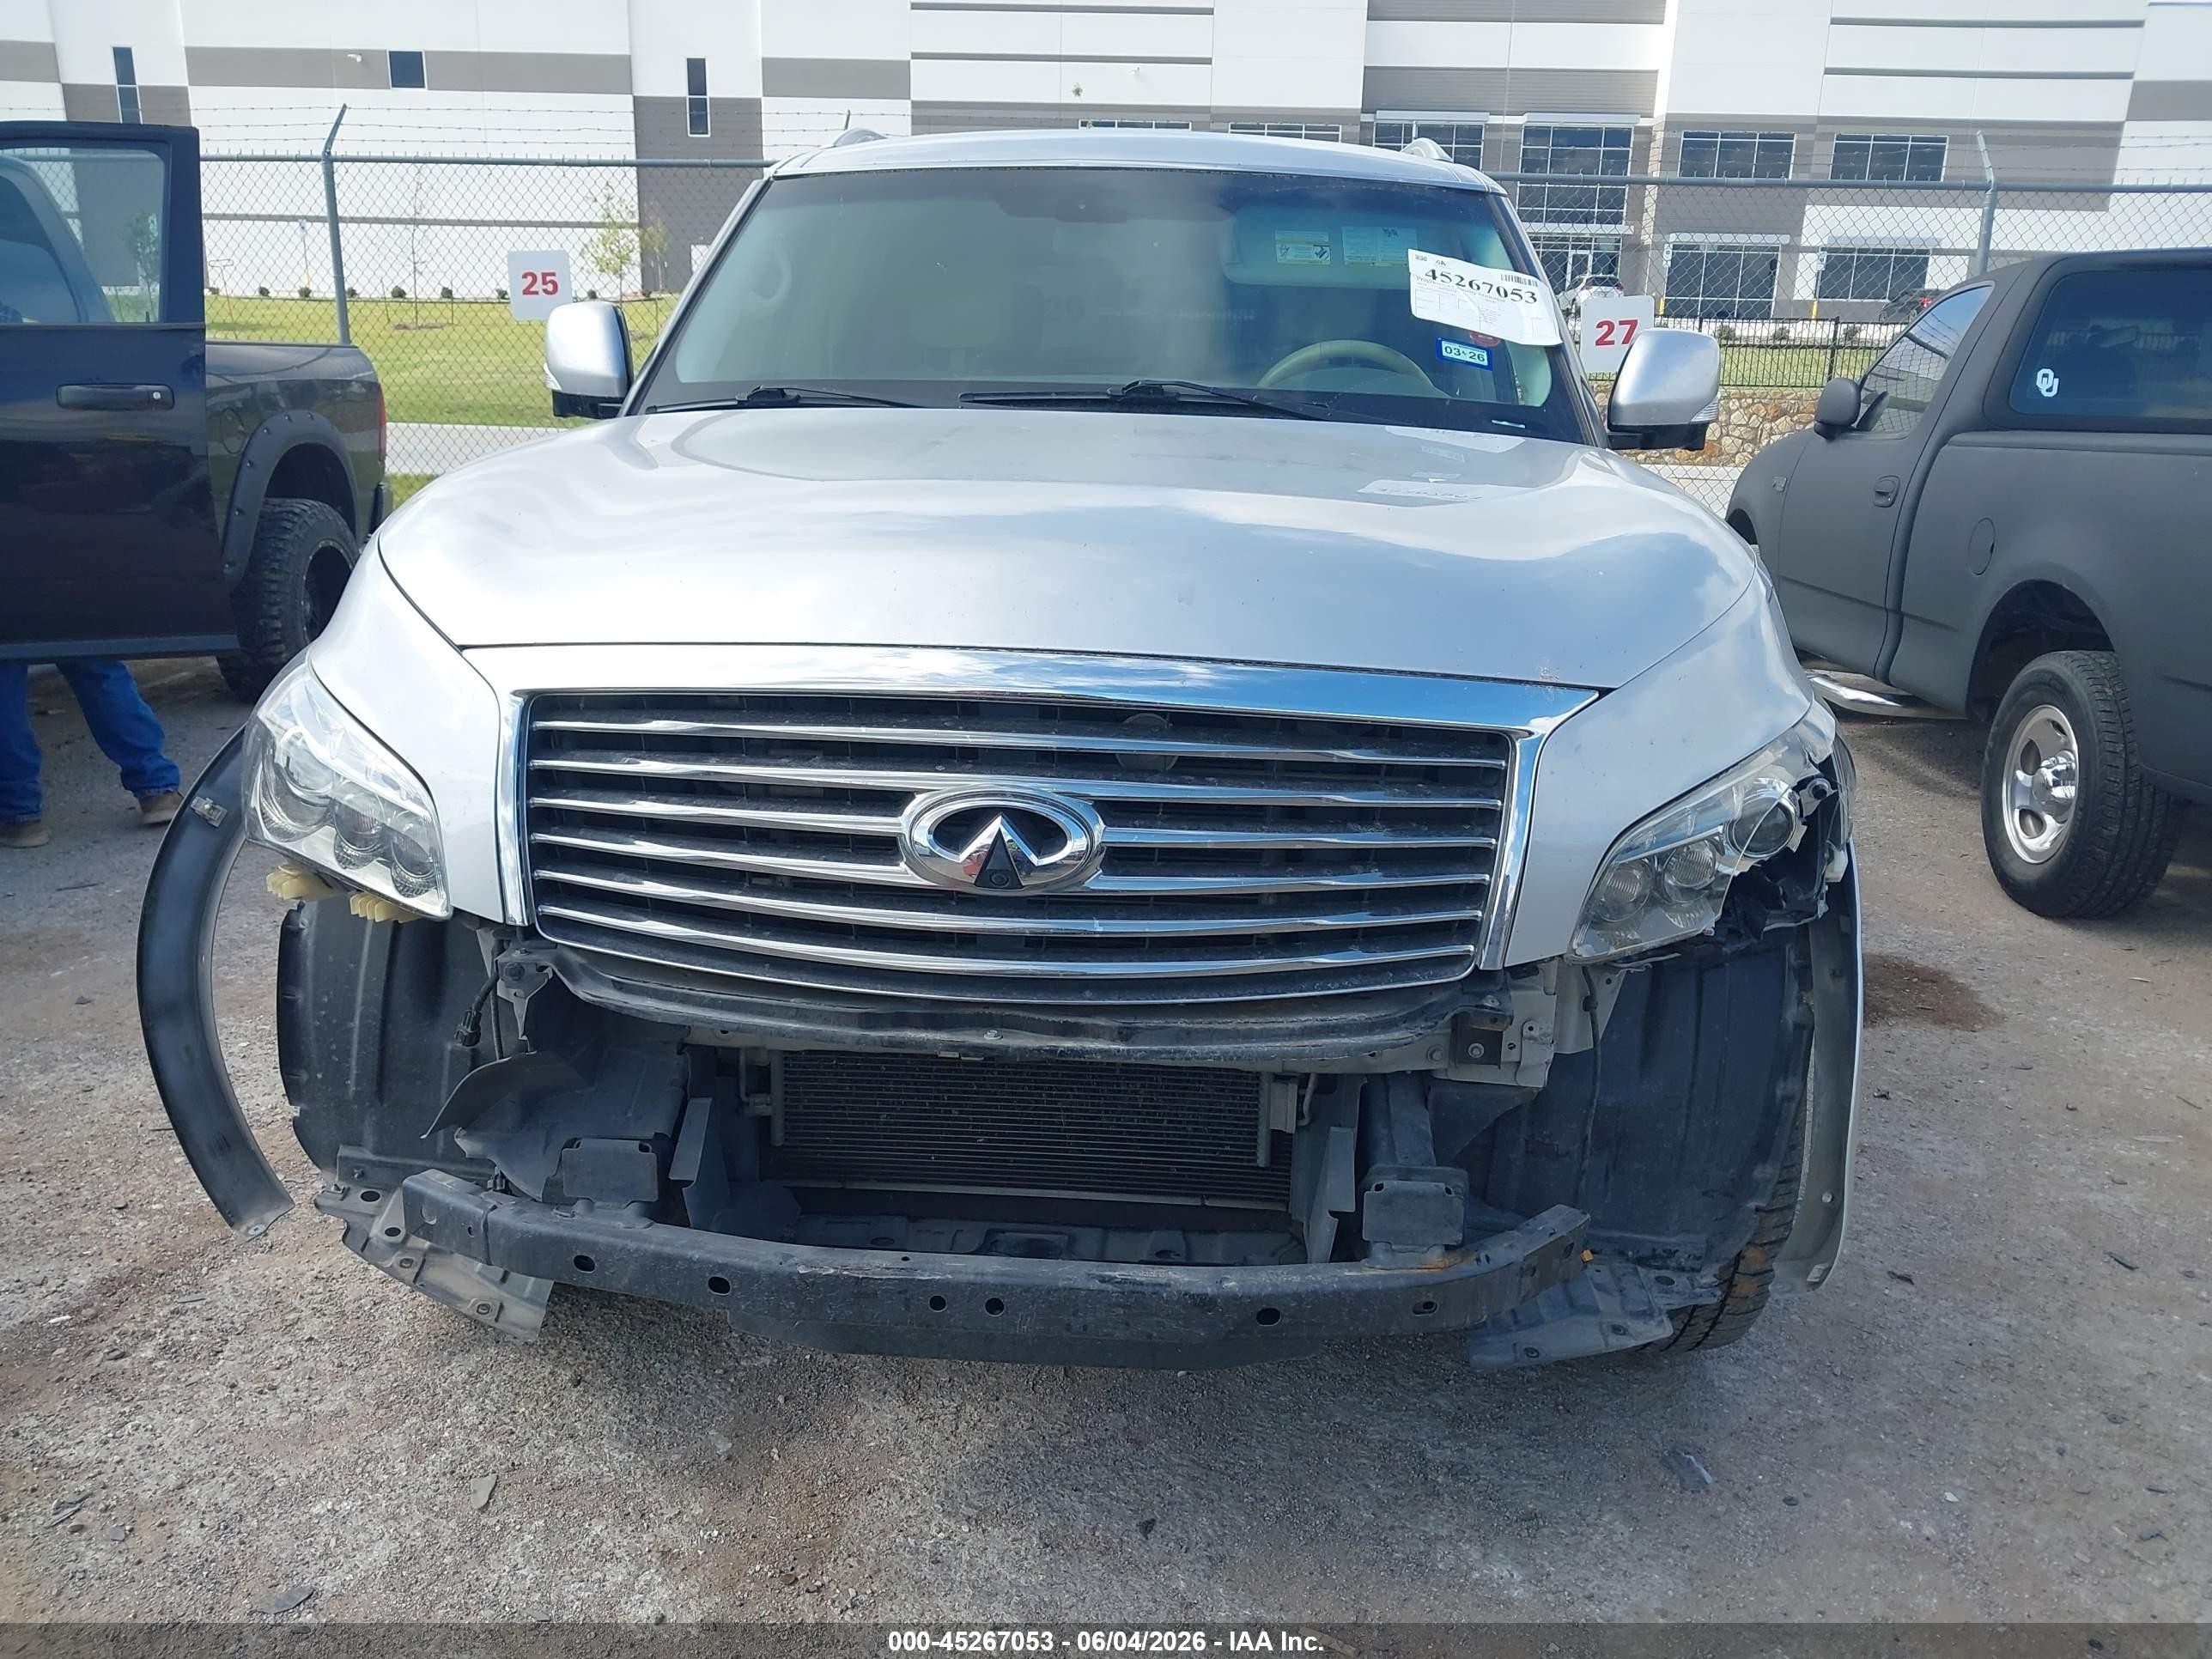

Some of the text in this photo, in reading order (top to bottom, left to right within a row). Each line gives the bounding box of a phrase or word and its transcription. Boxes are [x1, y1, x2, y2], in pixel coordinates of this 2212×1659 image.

[521, 271, 558, 295] 25
[1425, 269, 1537, 304] 45267053
[1595, 319, 1638, 346] 27
[1444, 345, 1462, 356] 03
[1468, 351, 1486, 362] 26
[2036, 368, 2059, 398] OU
